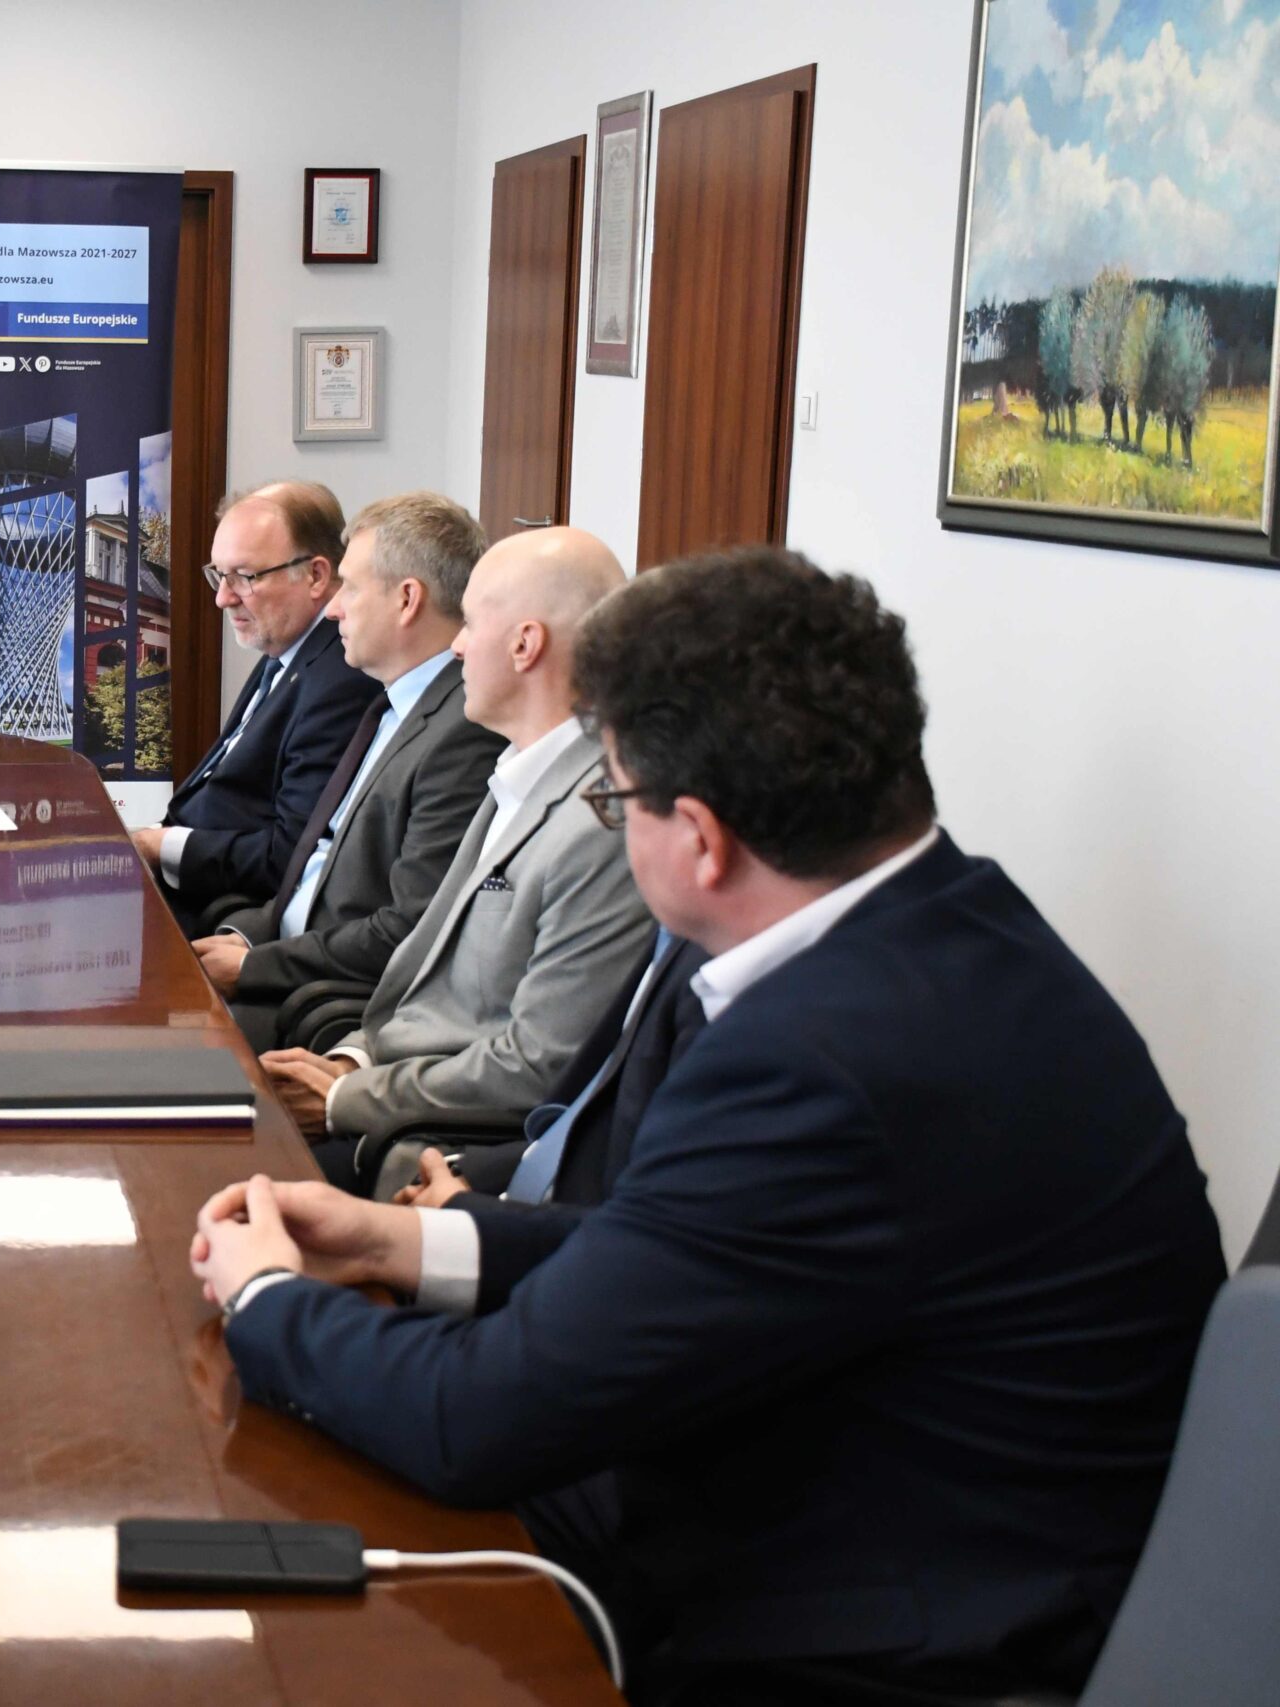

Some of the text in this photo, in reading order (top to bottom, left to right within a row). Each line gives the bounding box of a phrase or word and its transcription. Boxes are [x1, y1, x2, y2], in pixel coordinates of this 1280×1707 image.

[18, 246, 77, 257] Mazowsza
[81, 248, 137, 259] 2021-2027
[17, 312, 138, 328] Fundusze Europejskie
